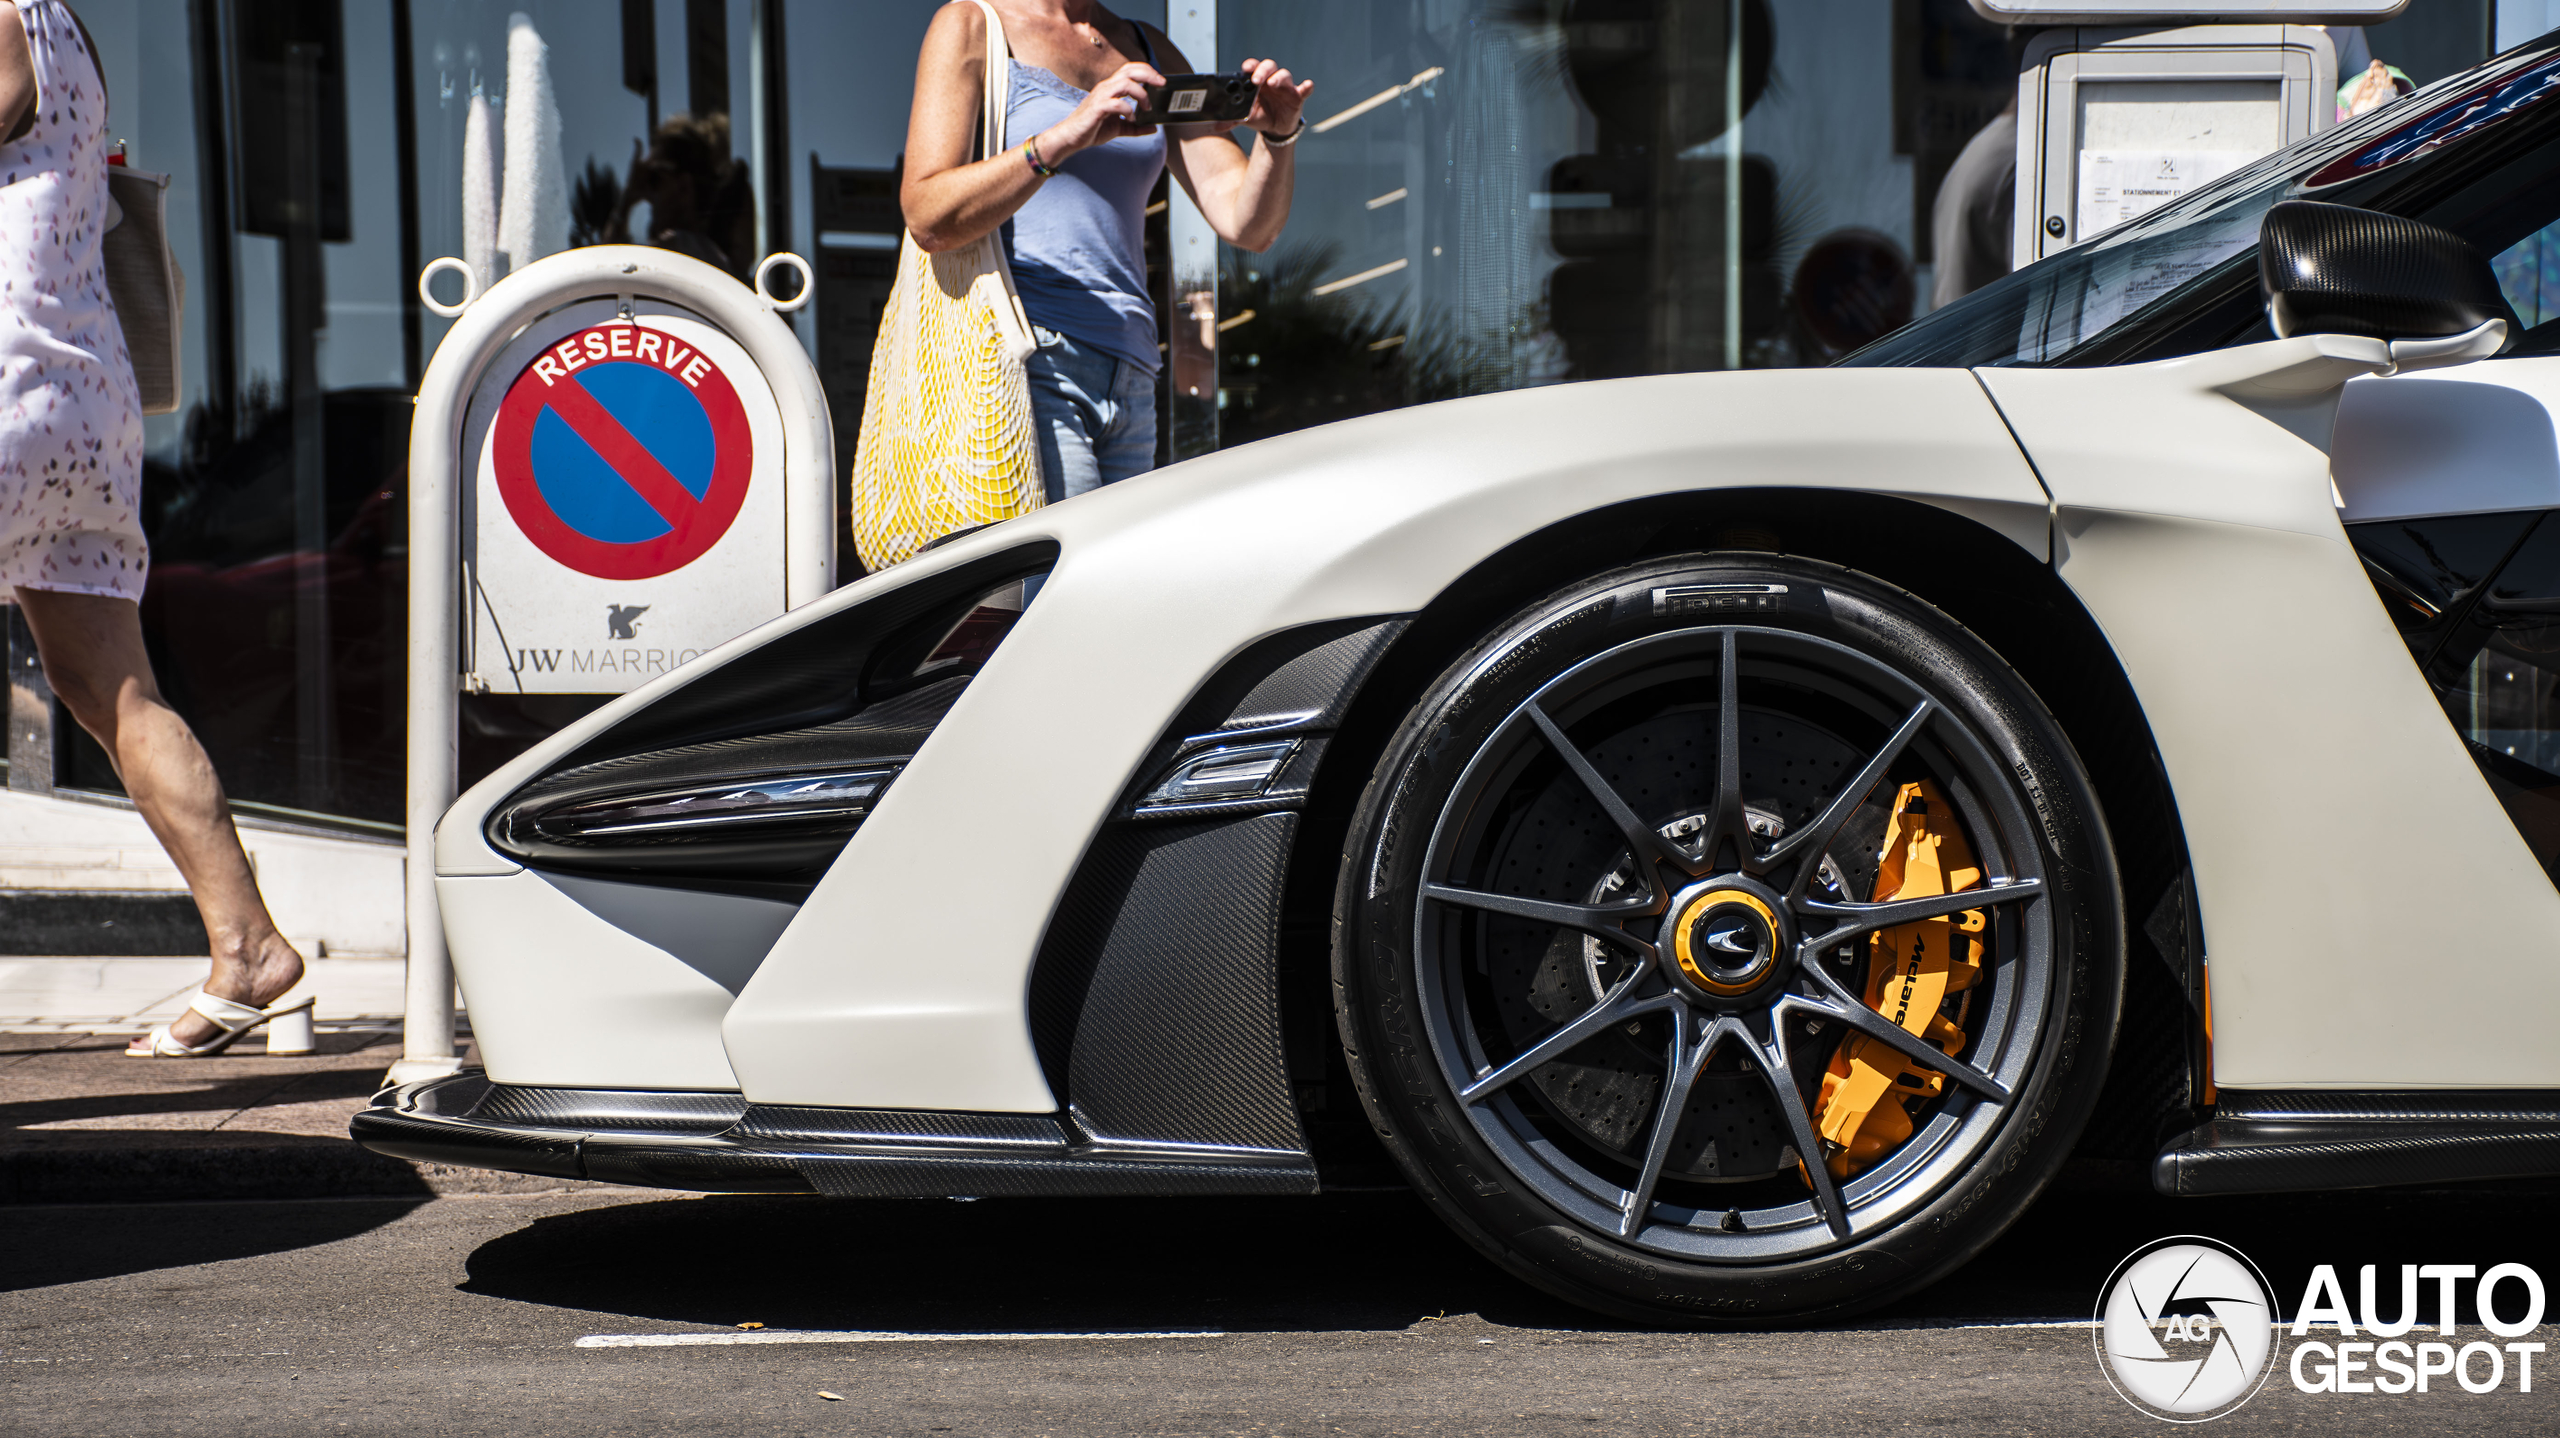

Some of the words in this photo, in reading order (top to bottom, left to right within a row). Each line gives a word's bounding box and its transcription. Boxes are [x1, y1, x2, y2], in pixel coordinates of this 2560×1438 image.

[532, 329, 712, 388] RESERVE
[1651, 583, 1789, 618] PIRELLI
[509, 649, 562, 673] JW
[572, 649, 713, 673] MARRIO
[2014, 760, 2033, 783] DOT
[1895, 932, 1925, 1026] McLare
[1375, 943, 1462, 1151] ZERO
[1455, 1161, 1508, 1199] P
